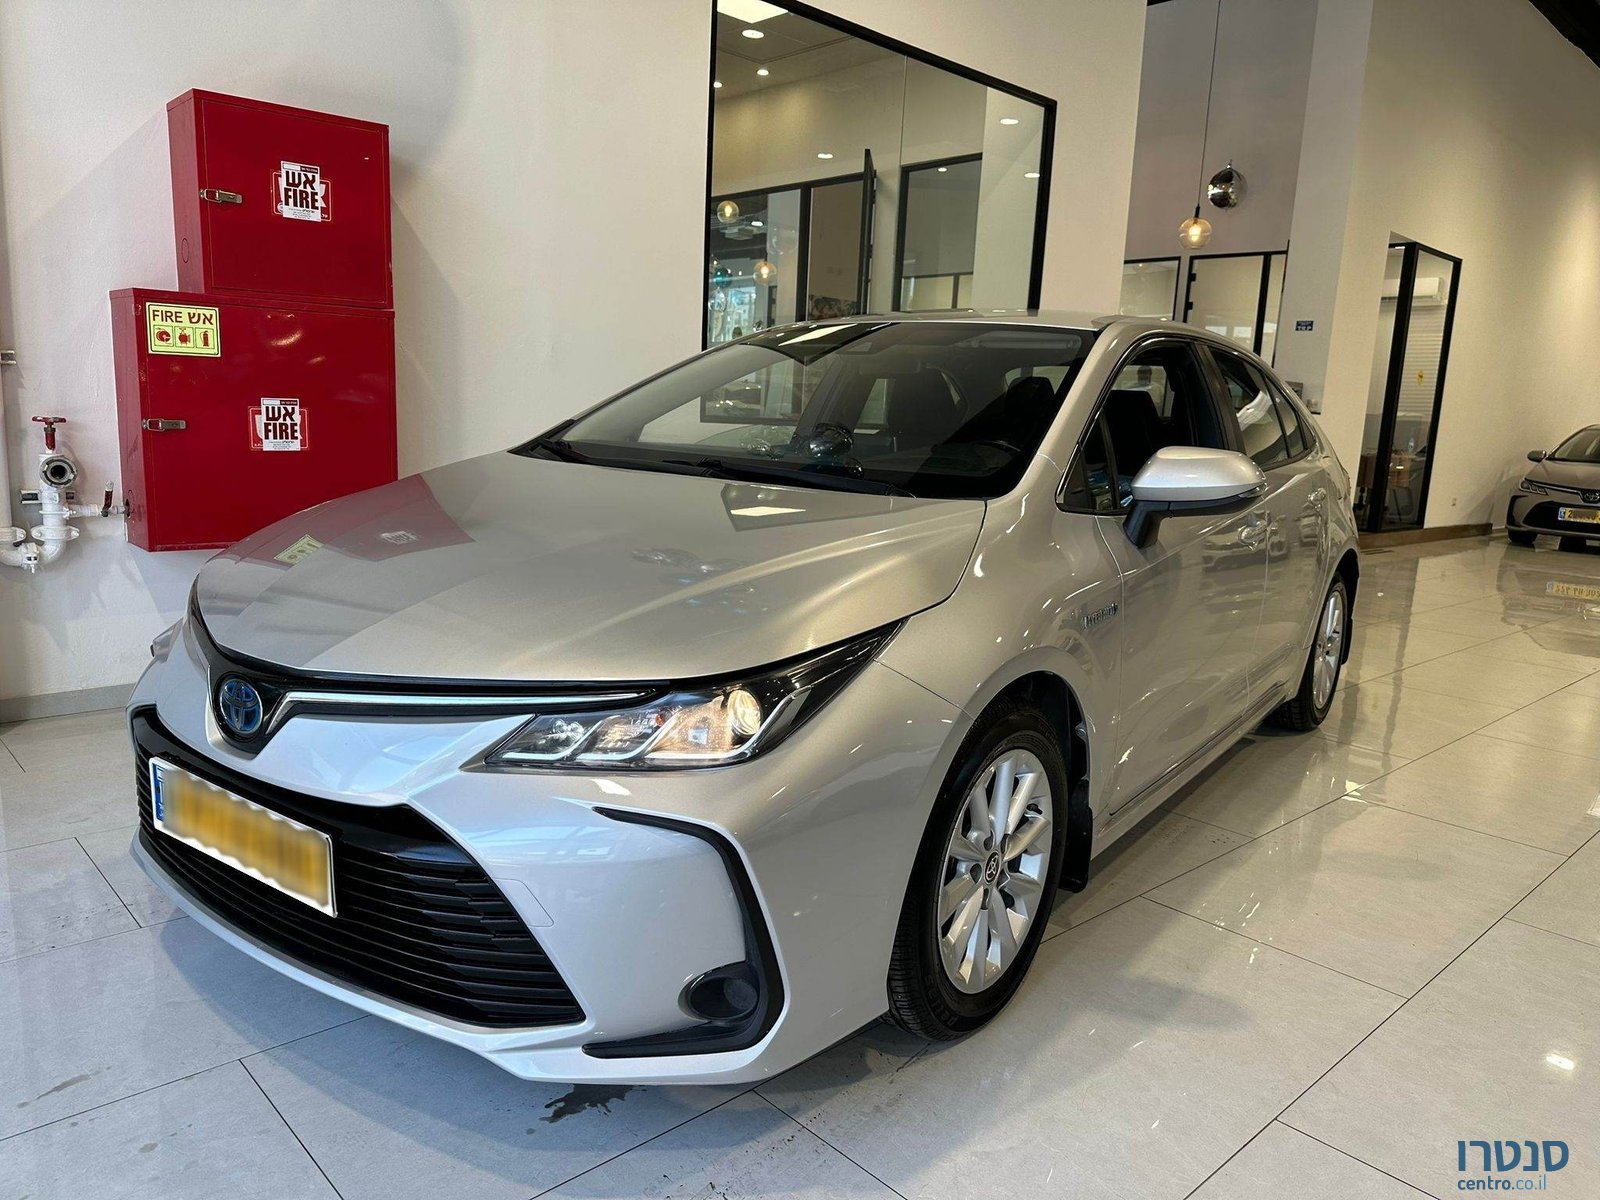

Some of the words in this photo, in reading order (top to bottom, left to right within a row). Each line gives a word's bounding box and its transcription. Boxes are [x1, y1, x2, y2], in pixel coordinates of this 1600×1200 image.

[285, 170, 316, 191] אש
[284, 187, 319, 210] FIRE
[152, 309, 183, 324] FIRE
[187, 312, 214, 326] אש
[265, 405, 296, 422] אש
[264, 422, 299, 440] FIRE
